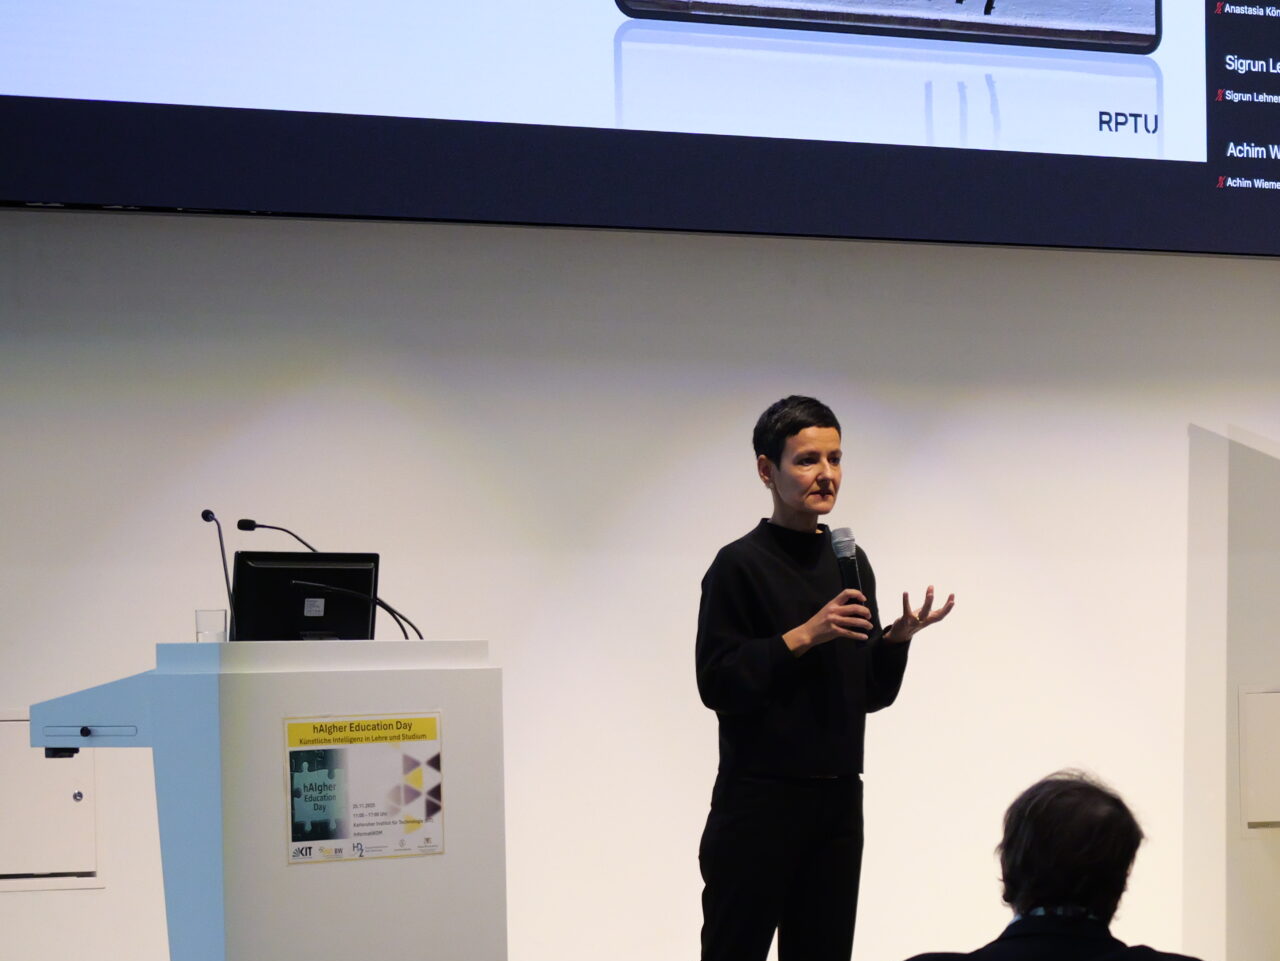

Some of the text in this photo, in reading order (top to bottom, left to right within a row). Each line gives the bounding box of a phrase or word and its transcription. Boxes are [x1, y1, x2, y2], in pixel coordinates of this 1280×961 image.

[1224, 3, 1264, 16] Anastasia
[1225, 55, 1267, 74] Sigrun
[1225, 90, 1252, 103] Sigrun
[1098, 110, 1159, 134] RPTU
[1226, 142, 1267, 159] Achim
[1226, 176, 1252, 188] Achim
[349, 721, 394, 733] Education
[395, 720, 413, 732] Day
[304, 793, 337, 803] Education
[313, 803, 327, 812] Day
[299, 847, 313, 856] KIT
